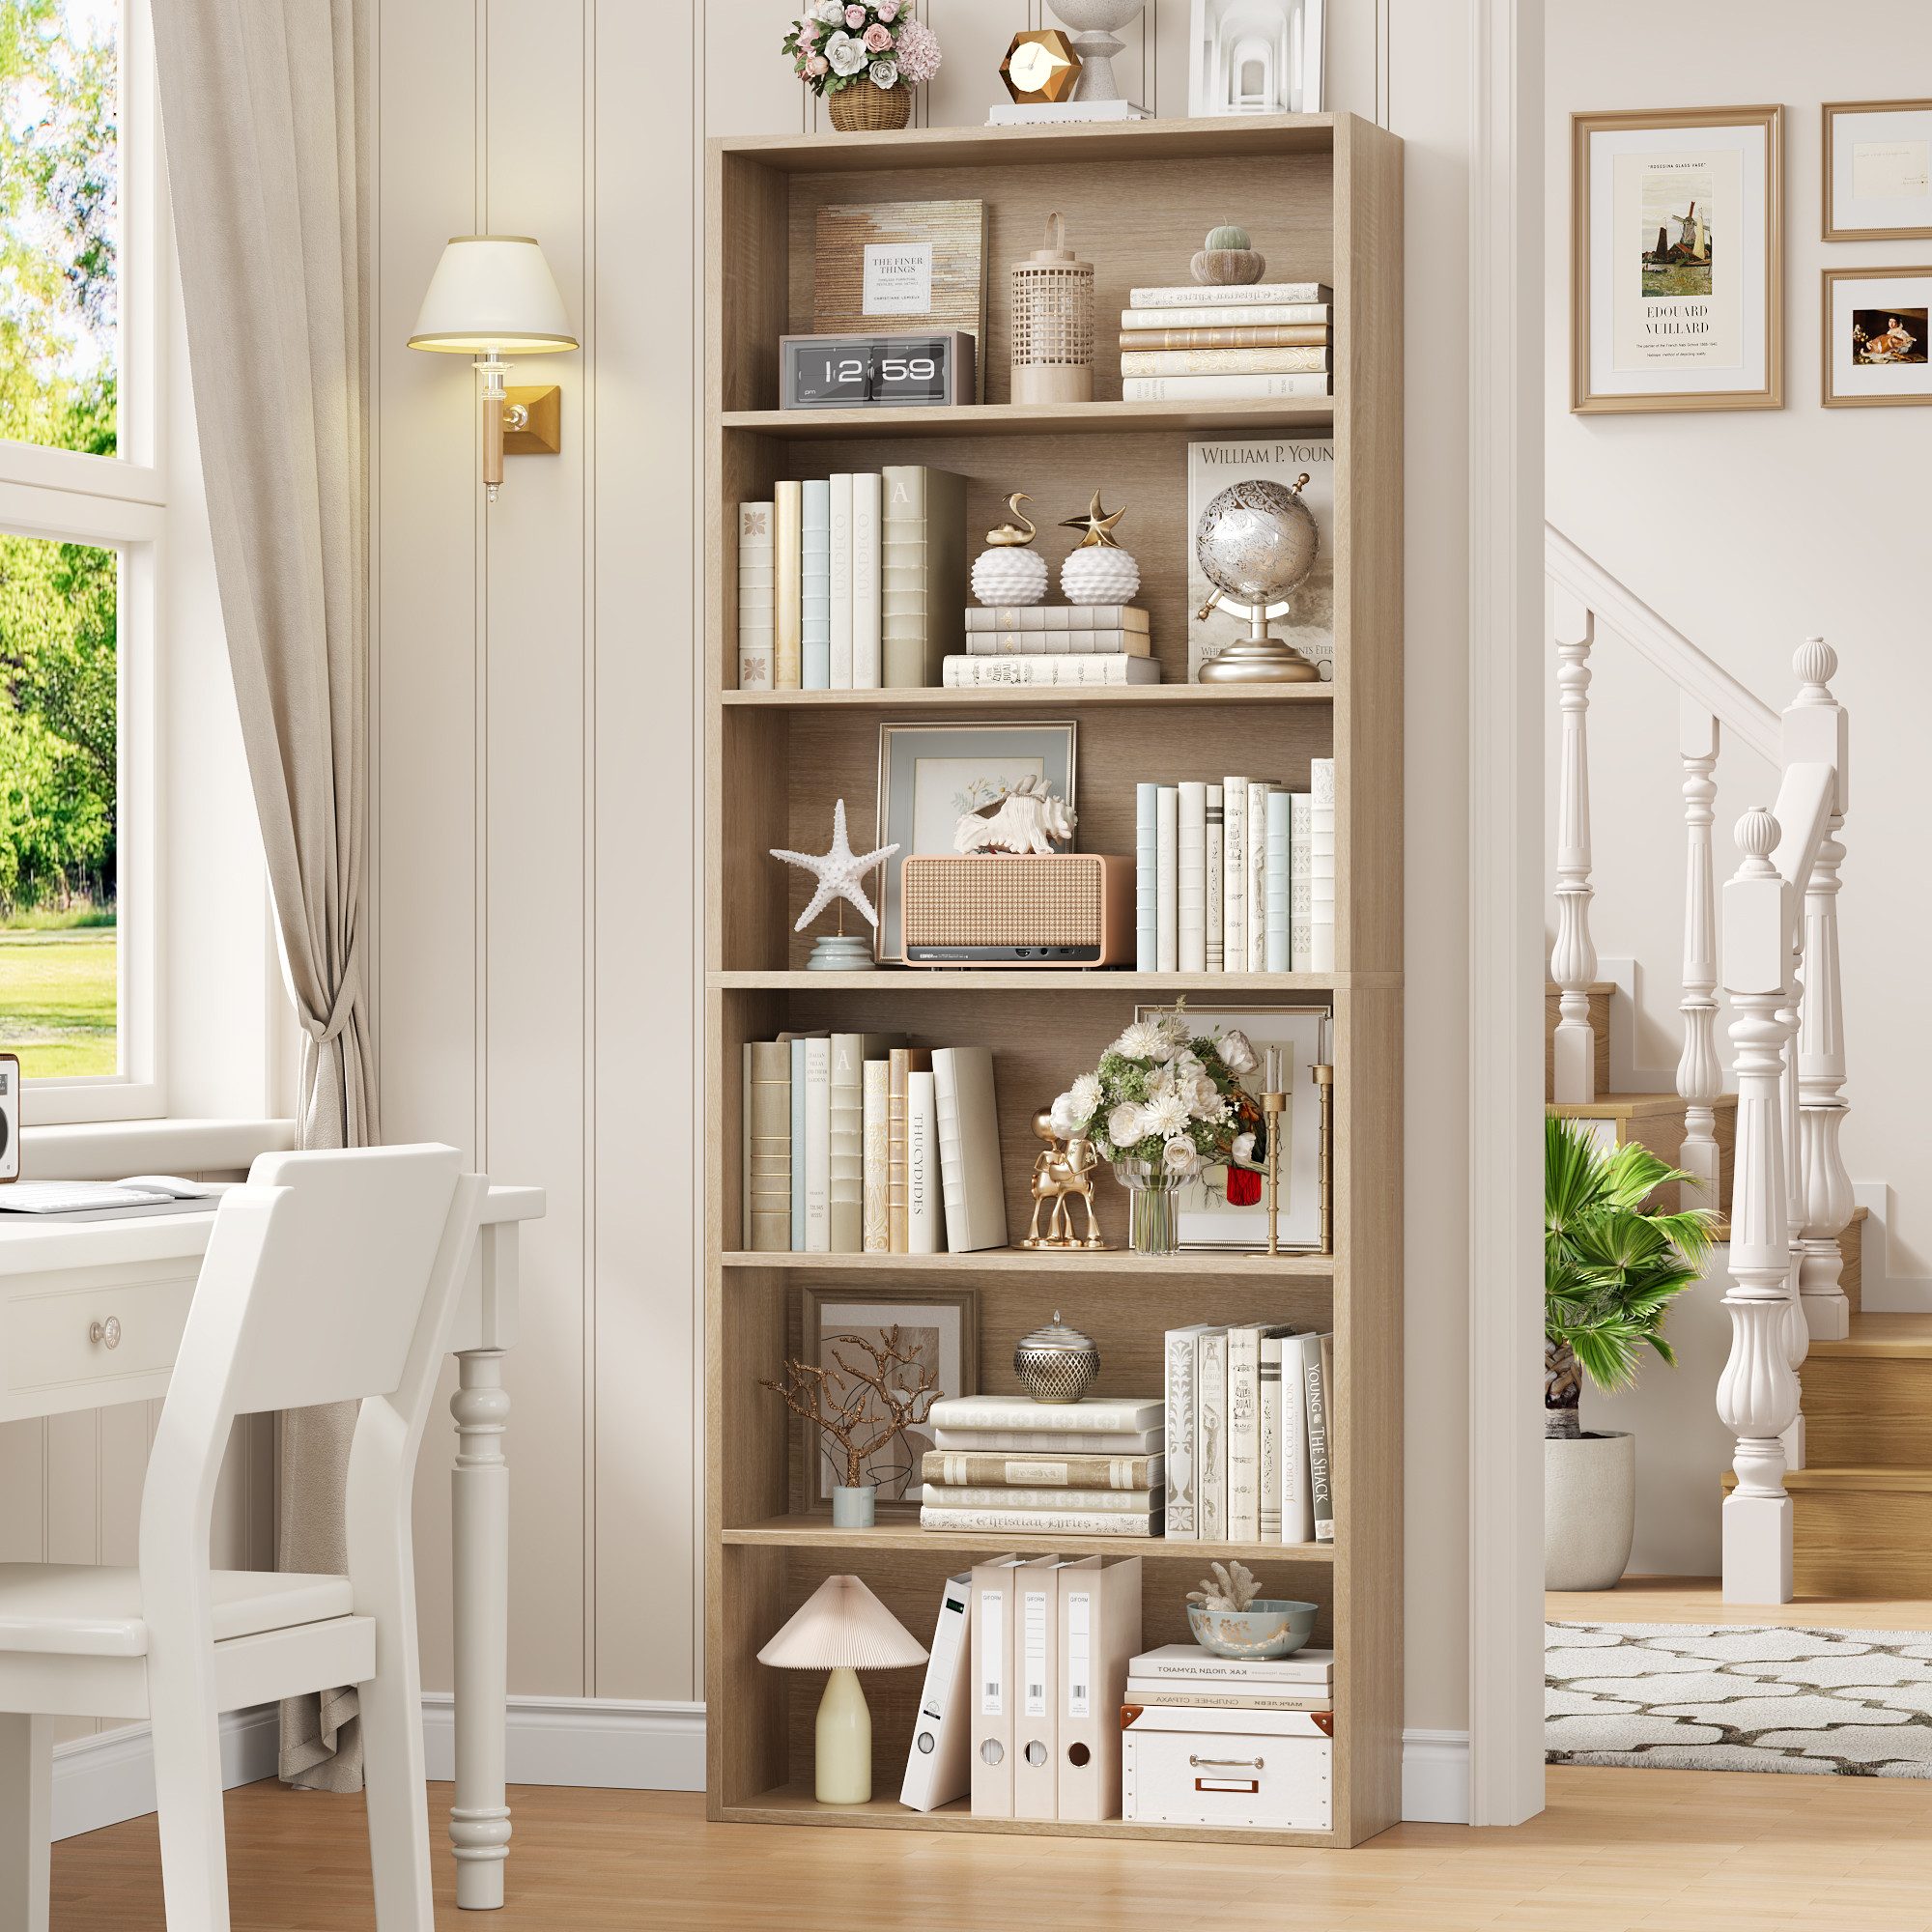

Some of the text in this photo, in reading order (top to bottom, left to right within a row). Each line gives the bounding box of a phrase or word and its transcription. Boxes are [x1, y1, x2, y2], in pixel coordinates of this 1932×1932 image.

[895, 257, 923, 265] FINER
[1647, 305, 1708, 318] EDOUARD
[1646, 322, 1709, 335] VUILLARD
[825, 359, 935, 383] 12 59
[1202, 445, 1334, 464] WILLIAM P. YOUN
[891, 483, 910, 503] A
[837, 1050, 852, 1070] A
[914, 1113, 923, 1215] THUCYDIDES
[1308, 1363, 1322, 1412] YOUNG
[1285, 1383, 1295, 1503] JUMBO COLLECTION
[1311, 1427, 1328, 1503] THE SHACK
